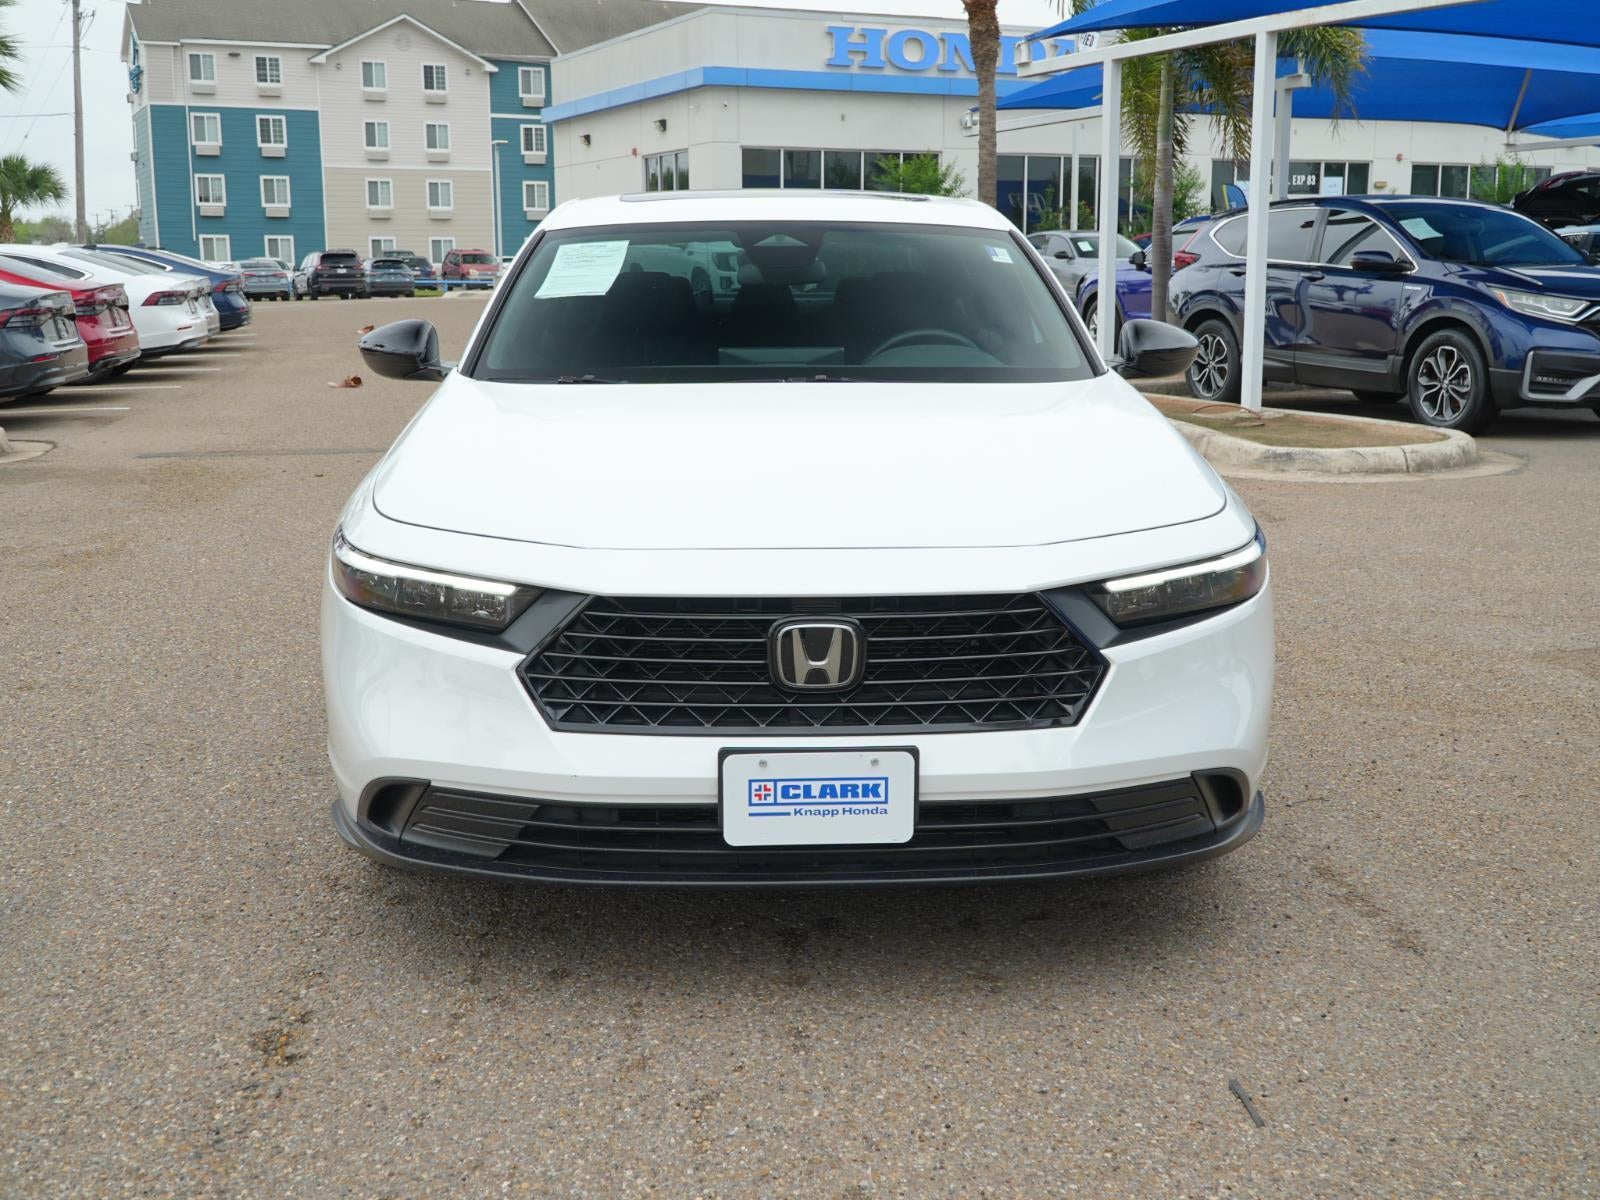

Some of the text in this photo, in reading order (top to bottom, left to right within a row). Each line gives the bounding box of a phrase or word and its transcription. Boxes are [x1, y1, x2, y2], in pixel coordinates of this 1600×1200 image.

[1292, 174, 1316, 186] EXP 83
[780, 783, 882, 800] CLARK
[793, 806, 888, 817] Knapp Honda
